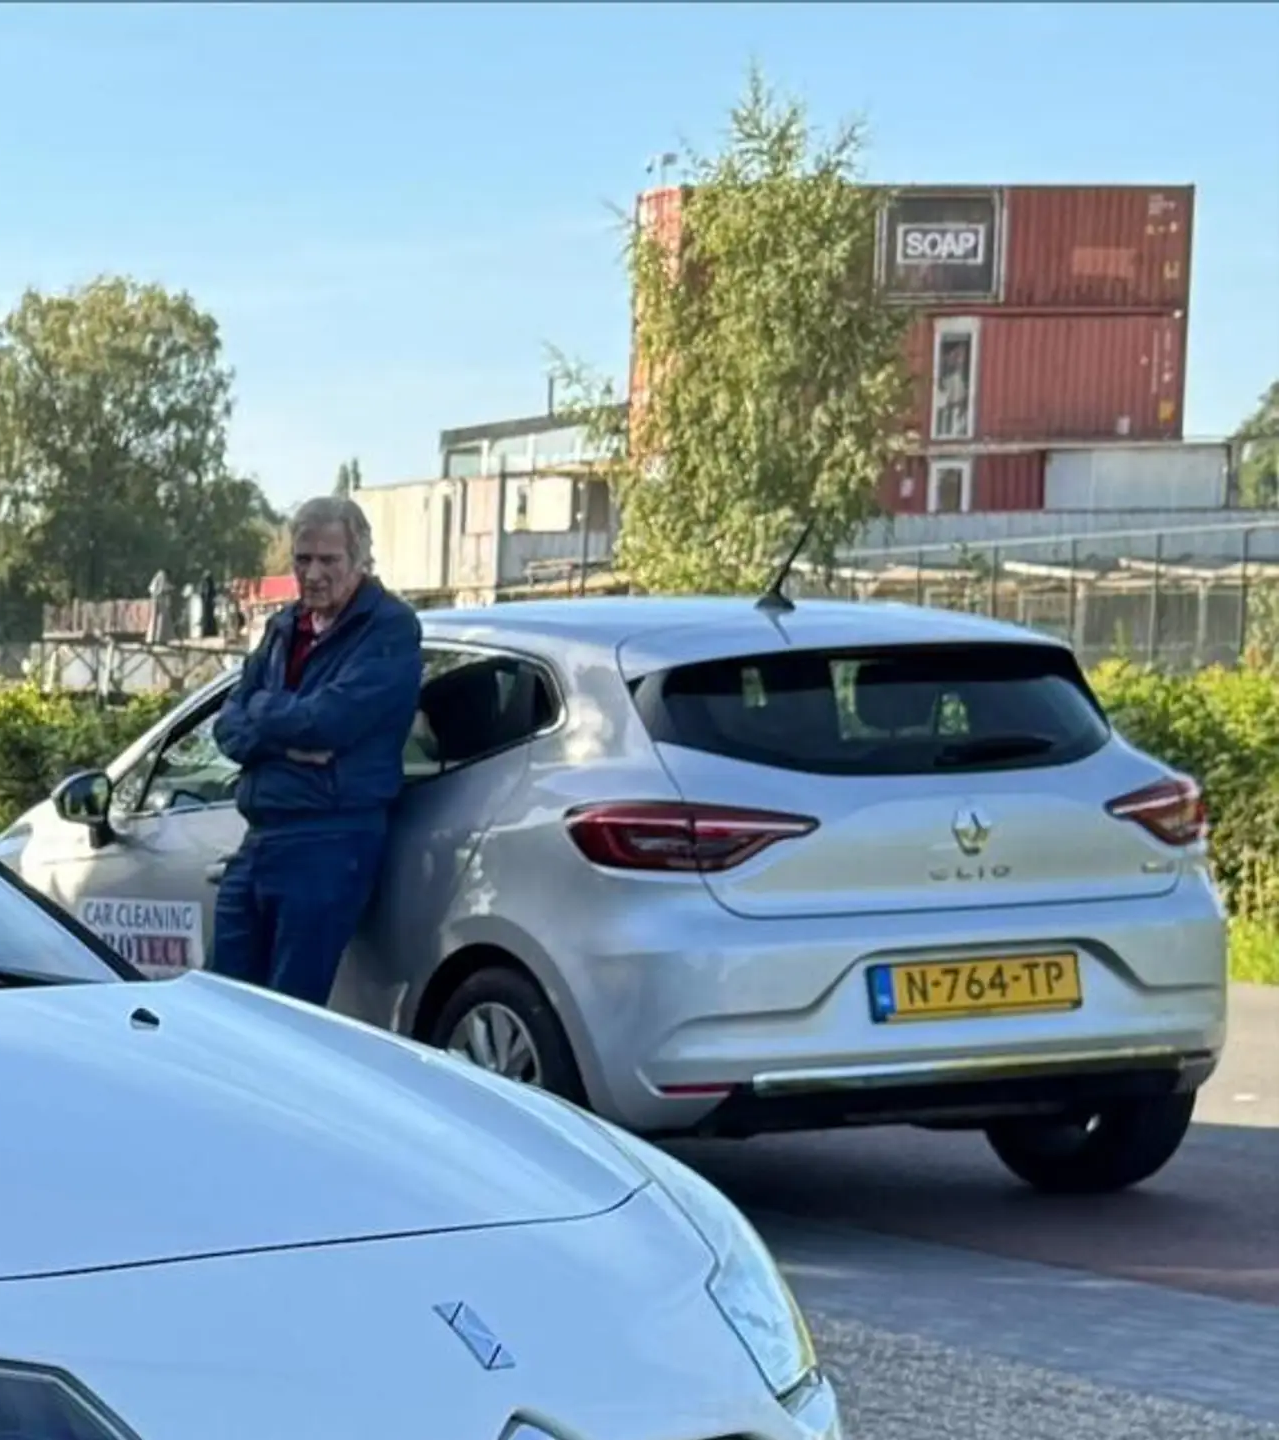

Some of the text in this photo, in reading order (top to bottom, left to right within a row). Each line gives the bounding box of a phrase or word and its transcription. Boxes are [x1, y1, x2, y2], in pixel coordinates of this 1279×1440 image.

[906, 231, 976, 258] SOAP
[84, 901, 194, 930] CAR CLEANING
[906, 960, 1064, 1004] N-764-TP
